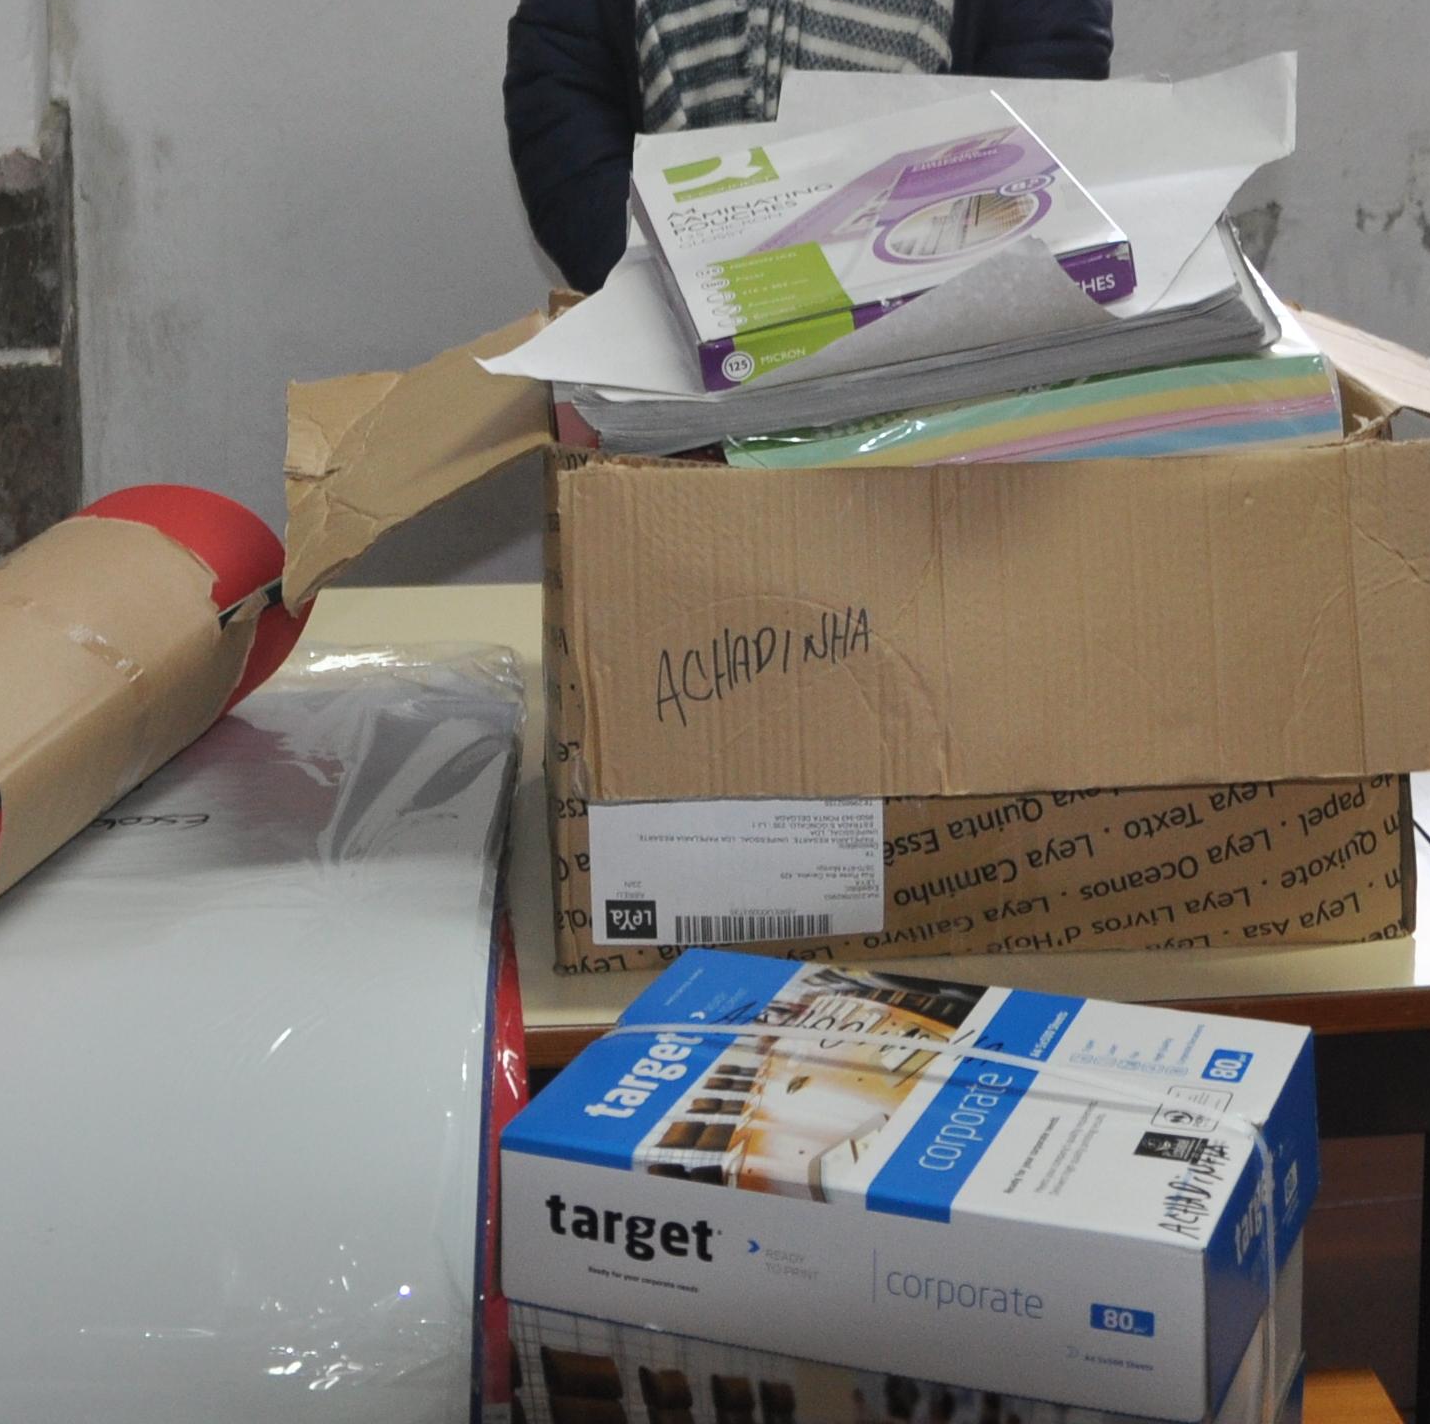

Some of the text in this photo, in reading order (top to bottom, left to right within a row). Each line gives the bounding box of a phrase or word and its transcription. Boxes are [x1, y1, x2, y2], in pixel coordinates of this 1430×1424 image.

[670, 183, 834, 228] LAMINATING
[1076, 274, 1117, 294] HES
[727, 346, 807, 373] 125 MICRON
[657, 606, 871, 727] ACHADINHA
[948, 797, 1044, 841] Quinta
[1124, 801, 1205, 839] Texto
[1298, 782, 1366, 837] Papel
[1026, 832, 1095, 869] Leya
[1206, 827, 1273, 865] Leya
[1280, 831, 1377, 889] Quixote
[893, 858, 1019, 907] Caminho
[1079, 855, 1200, 902] Oceanos
[983, 895, 1051, 923] Leya
[1091, 905, 1176, 934] Livros
[1185, 886, 1252, 915] Leya
[1300, 891, 1362, 926] Leya
[863, 913, 975, 949] Gailivro
[987, 924, 1082, 954] d'Hoje
[1242, 917, 1291, 939] Asa
[584, 1032, 704, 1119] target
[1209, 1057, 1243, 1080] 80
[919, 1072, 1013, 1172] corporate
[545, 1194, 713, 1262] target
[886, 1270, 1044, 1320] corporate
[1102, 1307, 1134, 1332] 80
